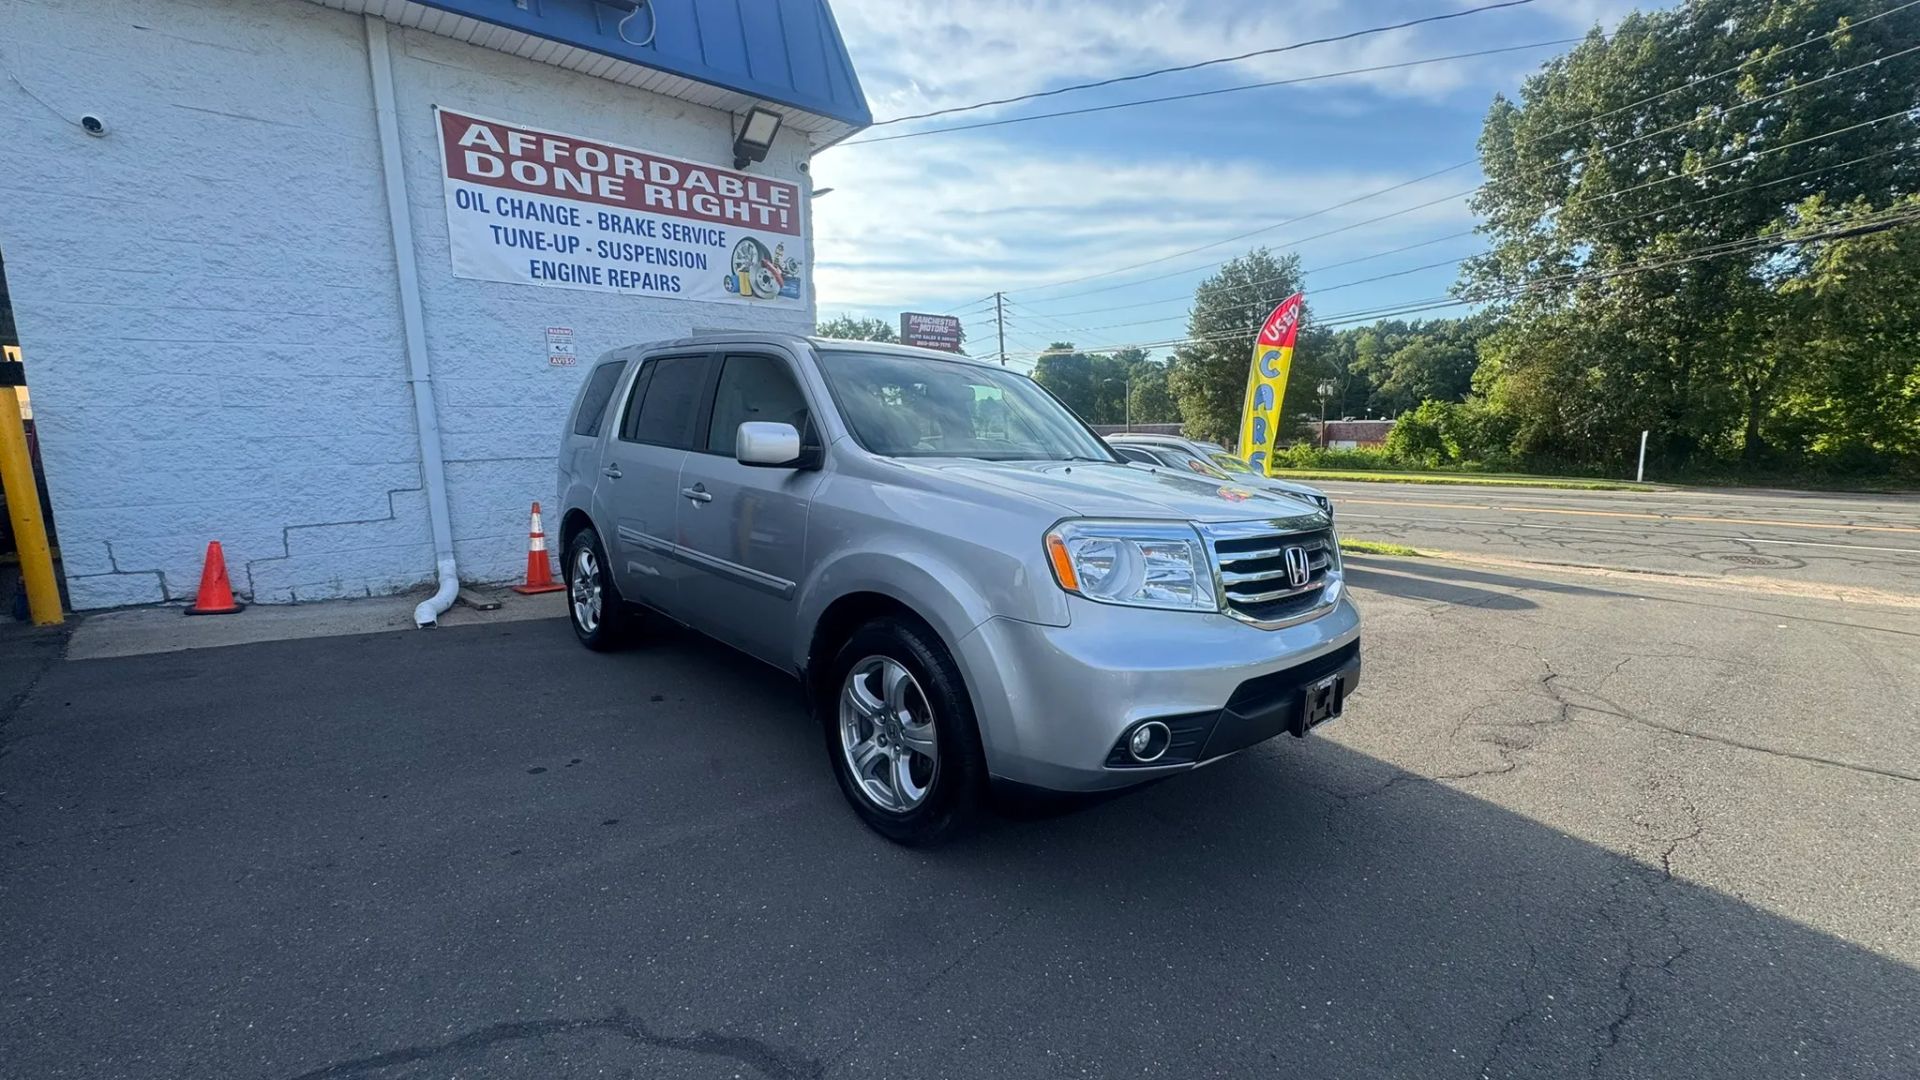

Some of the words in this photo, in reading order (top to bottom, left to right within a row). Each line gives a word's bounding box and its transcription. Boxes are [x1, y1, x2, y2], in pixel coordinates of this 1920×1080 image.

[457, 123, 791, 208] AFFORDABLE
[464, 150, 627, 201] DONE
[644, 184, 788, 229] RIGHT!
[455, 188, 490, 214] OIL
[496, 196, 581, 228] CHANGE
[598, 212, 656, 238] BRAKE
[662, 222, 726, 248] SERVICE
[489, 225, 580, 255] TUNE-UP
[597, 240, 707, 271] SUSPENSION
[530, 259, 603, 286] ENGINE
[607, 268, 681, 294] REPAIRS
[909, 315, 957, 326] MANCHESTER
[919, 323, 949, 333] MOTORS
[1264, 303, 1299, 342] USED
[1249, 350, 1282, 476] CARS
